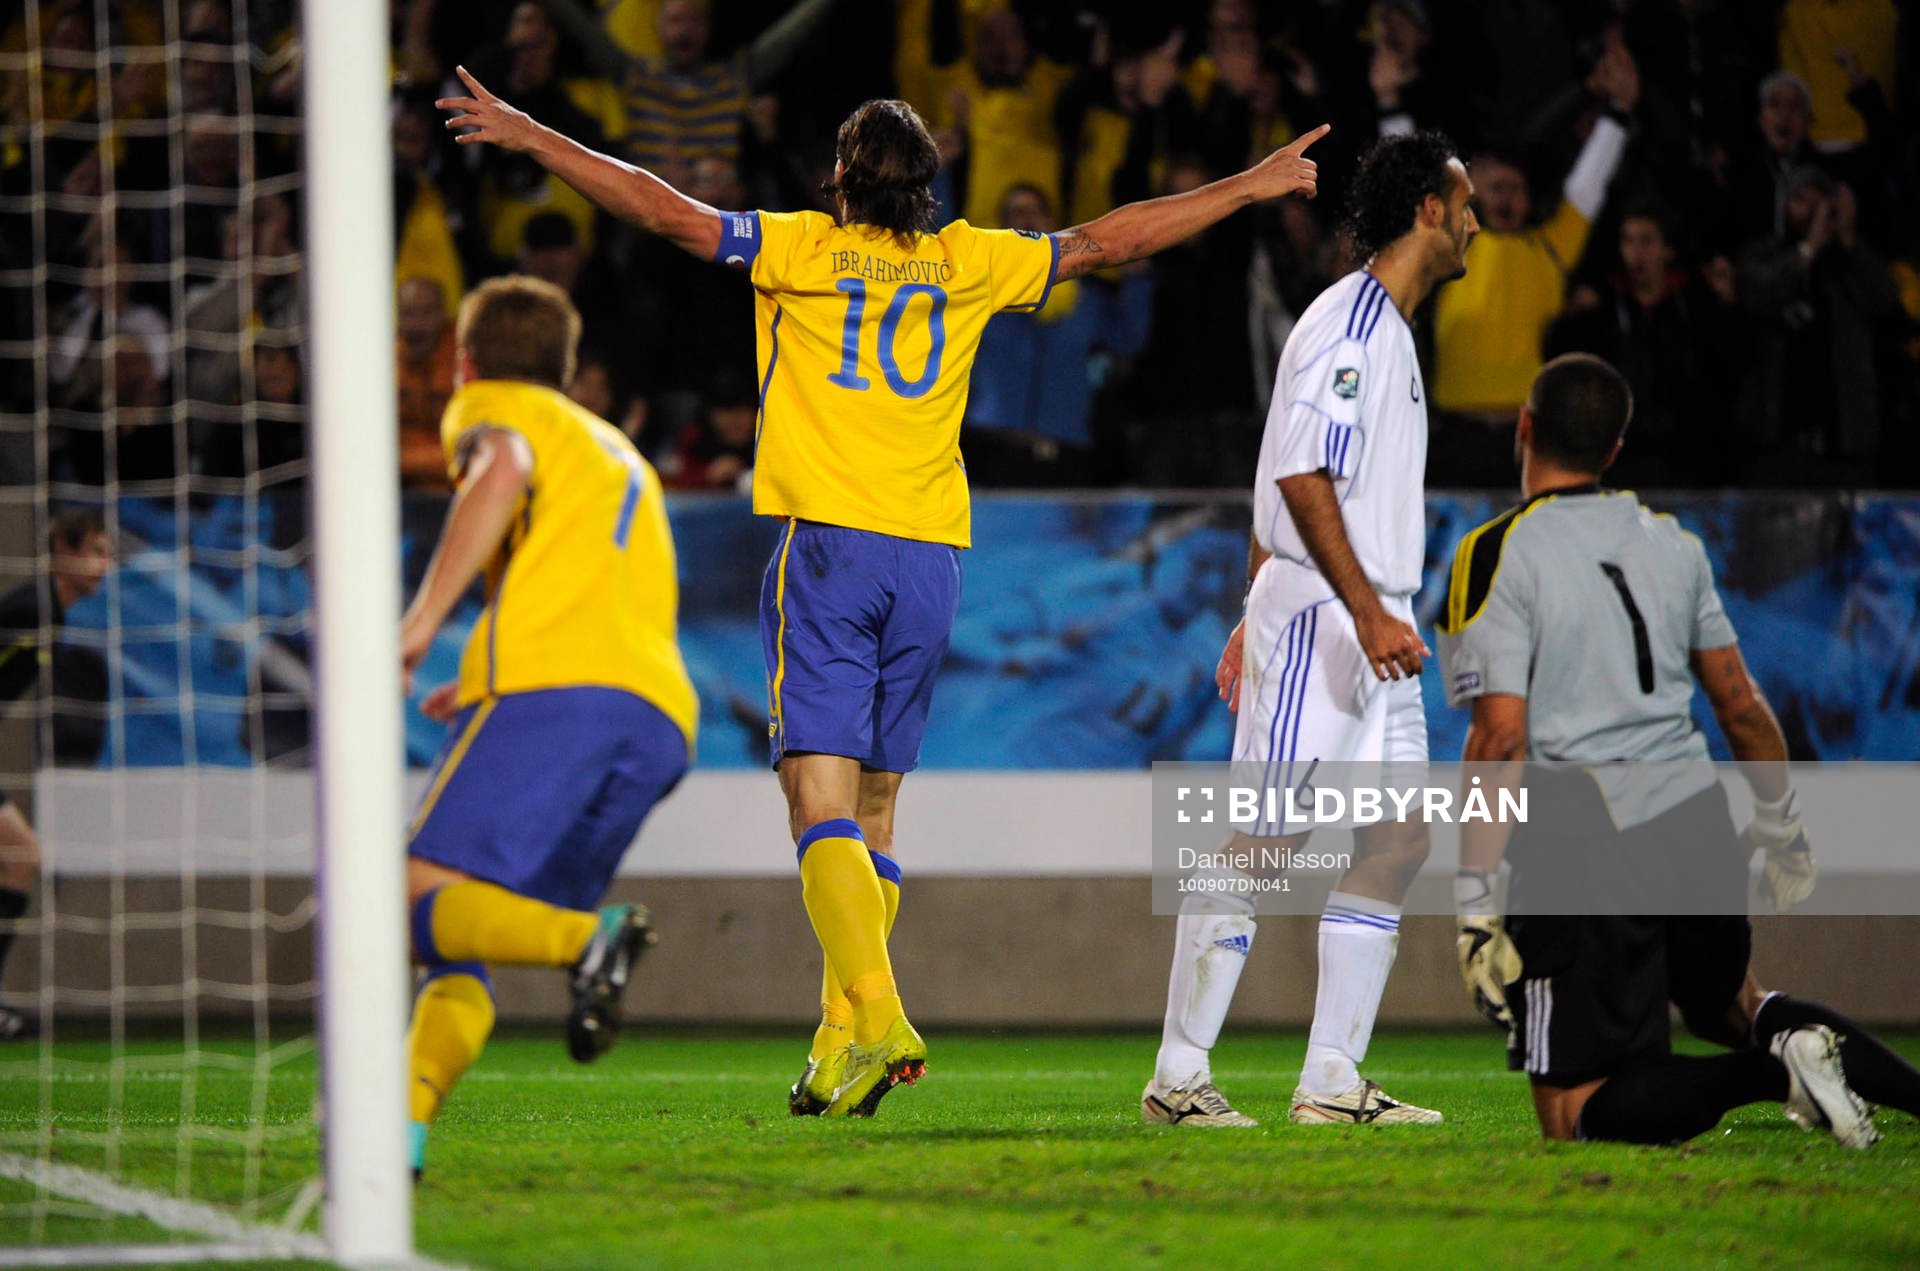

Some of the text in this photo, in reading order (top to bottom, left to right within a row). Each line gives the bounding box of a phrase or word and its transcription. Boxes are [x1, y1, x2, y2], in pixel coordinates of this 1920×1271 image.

[831, 250, 953, 285] IBRAHIMOVIĆ
[827, 277, 948, 398] 10
[1600, 560, 1655, 694] 1
[1294, 758, 1319, 811] 6
